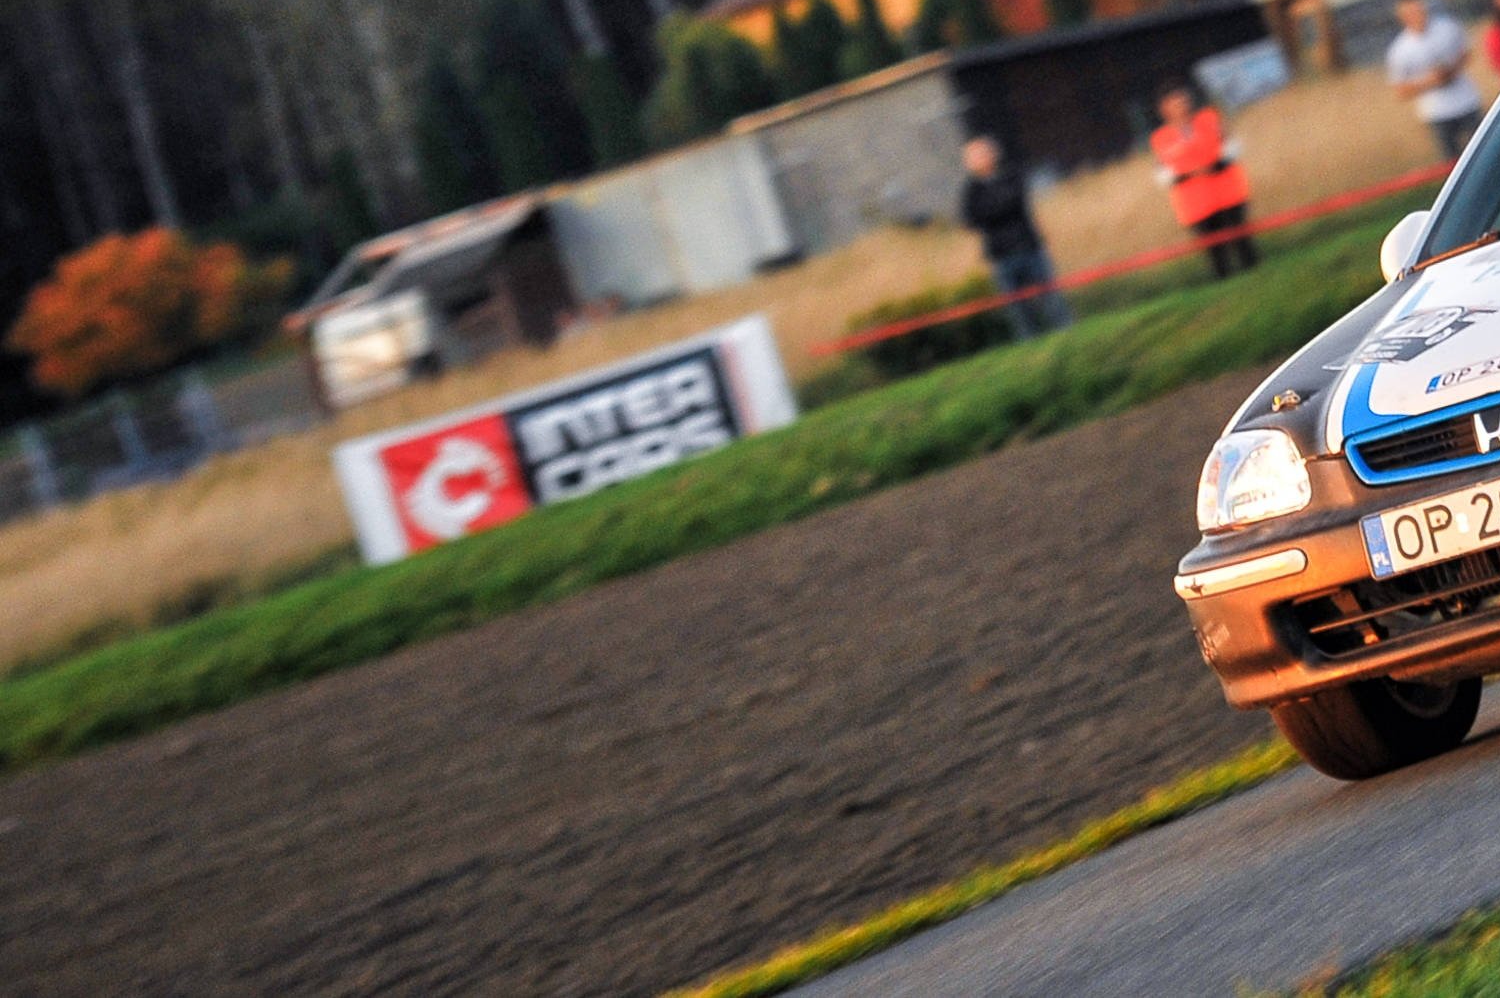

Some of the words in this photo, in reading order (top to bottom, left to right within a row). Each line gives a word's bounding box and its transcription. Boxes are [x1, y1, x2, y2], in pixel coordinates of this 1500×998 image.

[1440, 369, 1471, 388] OP
[1393, 504, 1453, 559] OP
[1371, 553, 1390, 567] PL
